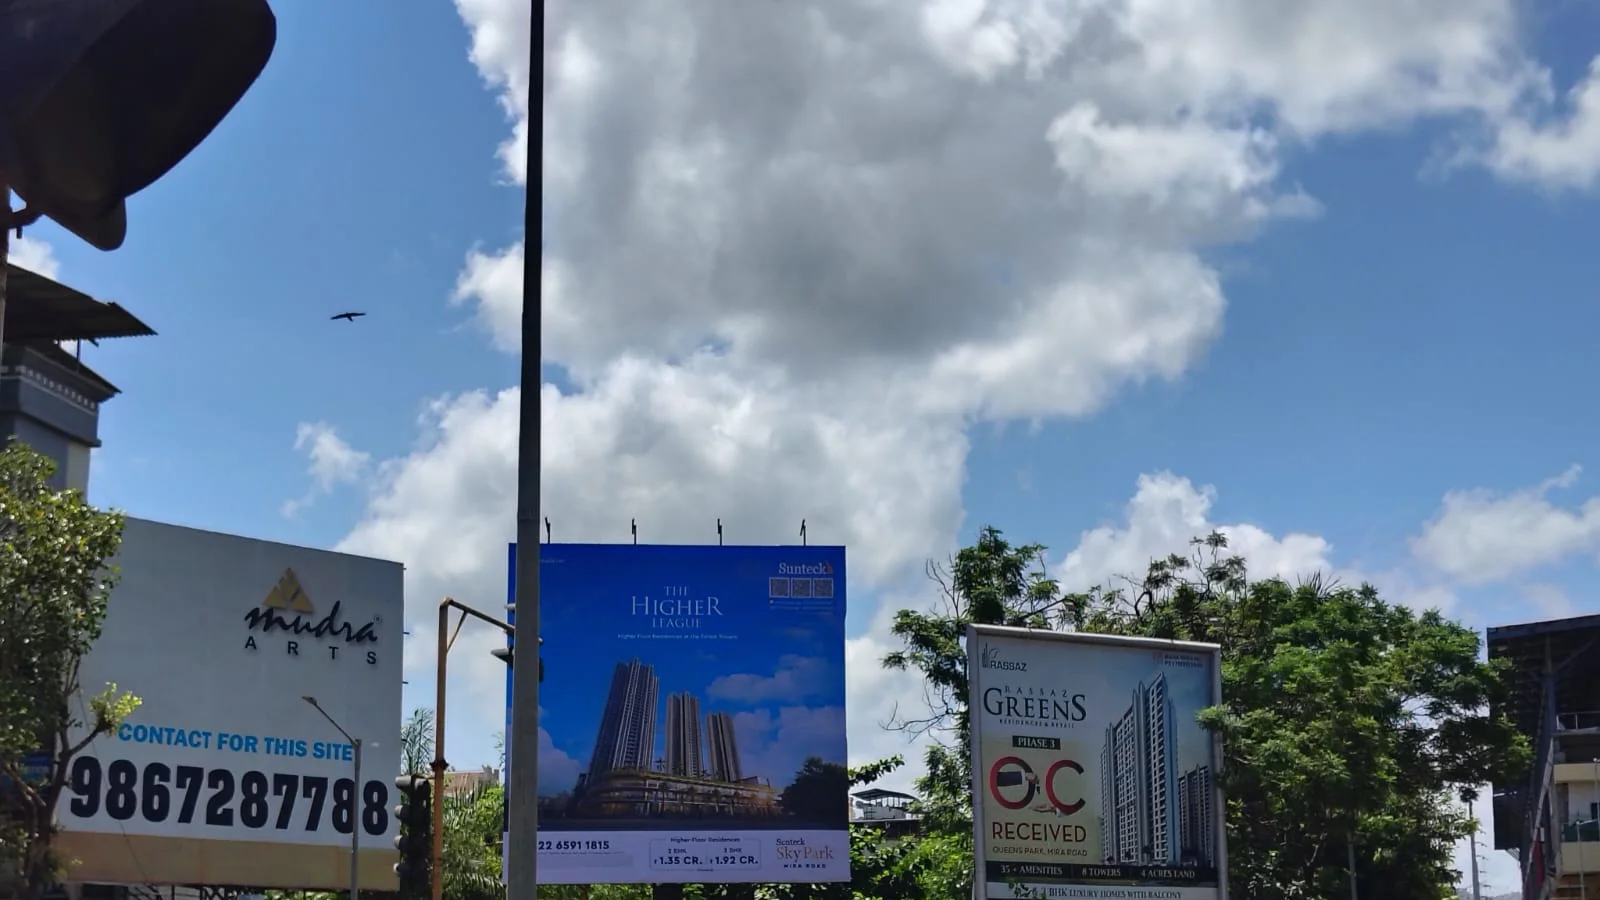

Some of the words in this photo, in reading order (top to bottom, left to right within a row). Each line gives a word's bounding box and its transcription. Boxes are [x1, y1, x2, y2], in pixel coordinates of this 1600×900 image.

[778, 562, 826, 575] Sunteck
[990, 660, 1027, 672] RASSAZ
[118, 724, 213, 750] CONTACT
[217, 733, 257, 753] FOR
[264, 737, 307, 757] THIS
[313, 742, 354, 761] SITE
[1018, 738, 1048, 747] PHASE
[70, 755, 390, 836] 9867287788
[992, 821, 1087, 843] RECEIVED
[555, 840, 582, 850] 6591
[585, 840, 610, 850] 1815
[1019, 865, 1063, 876] AMENITIES
[1088, 868, 1121, 878] TOWERS
